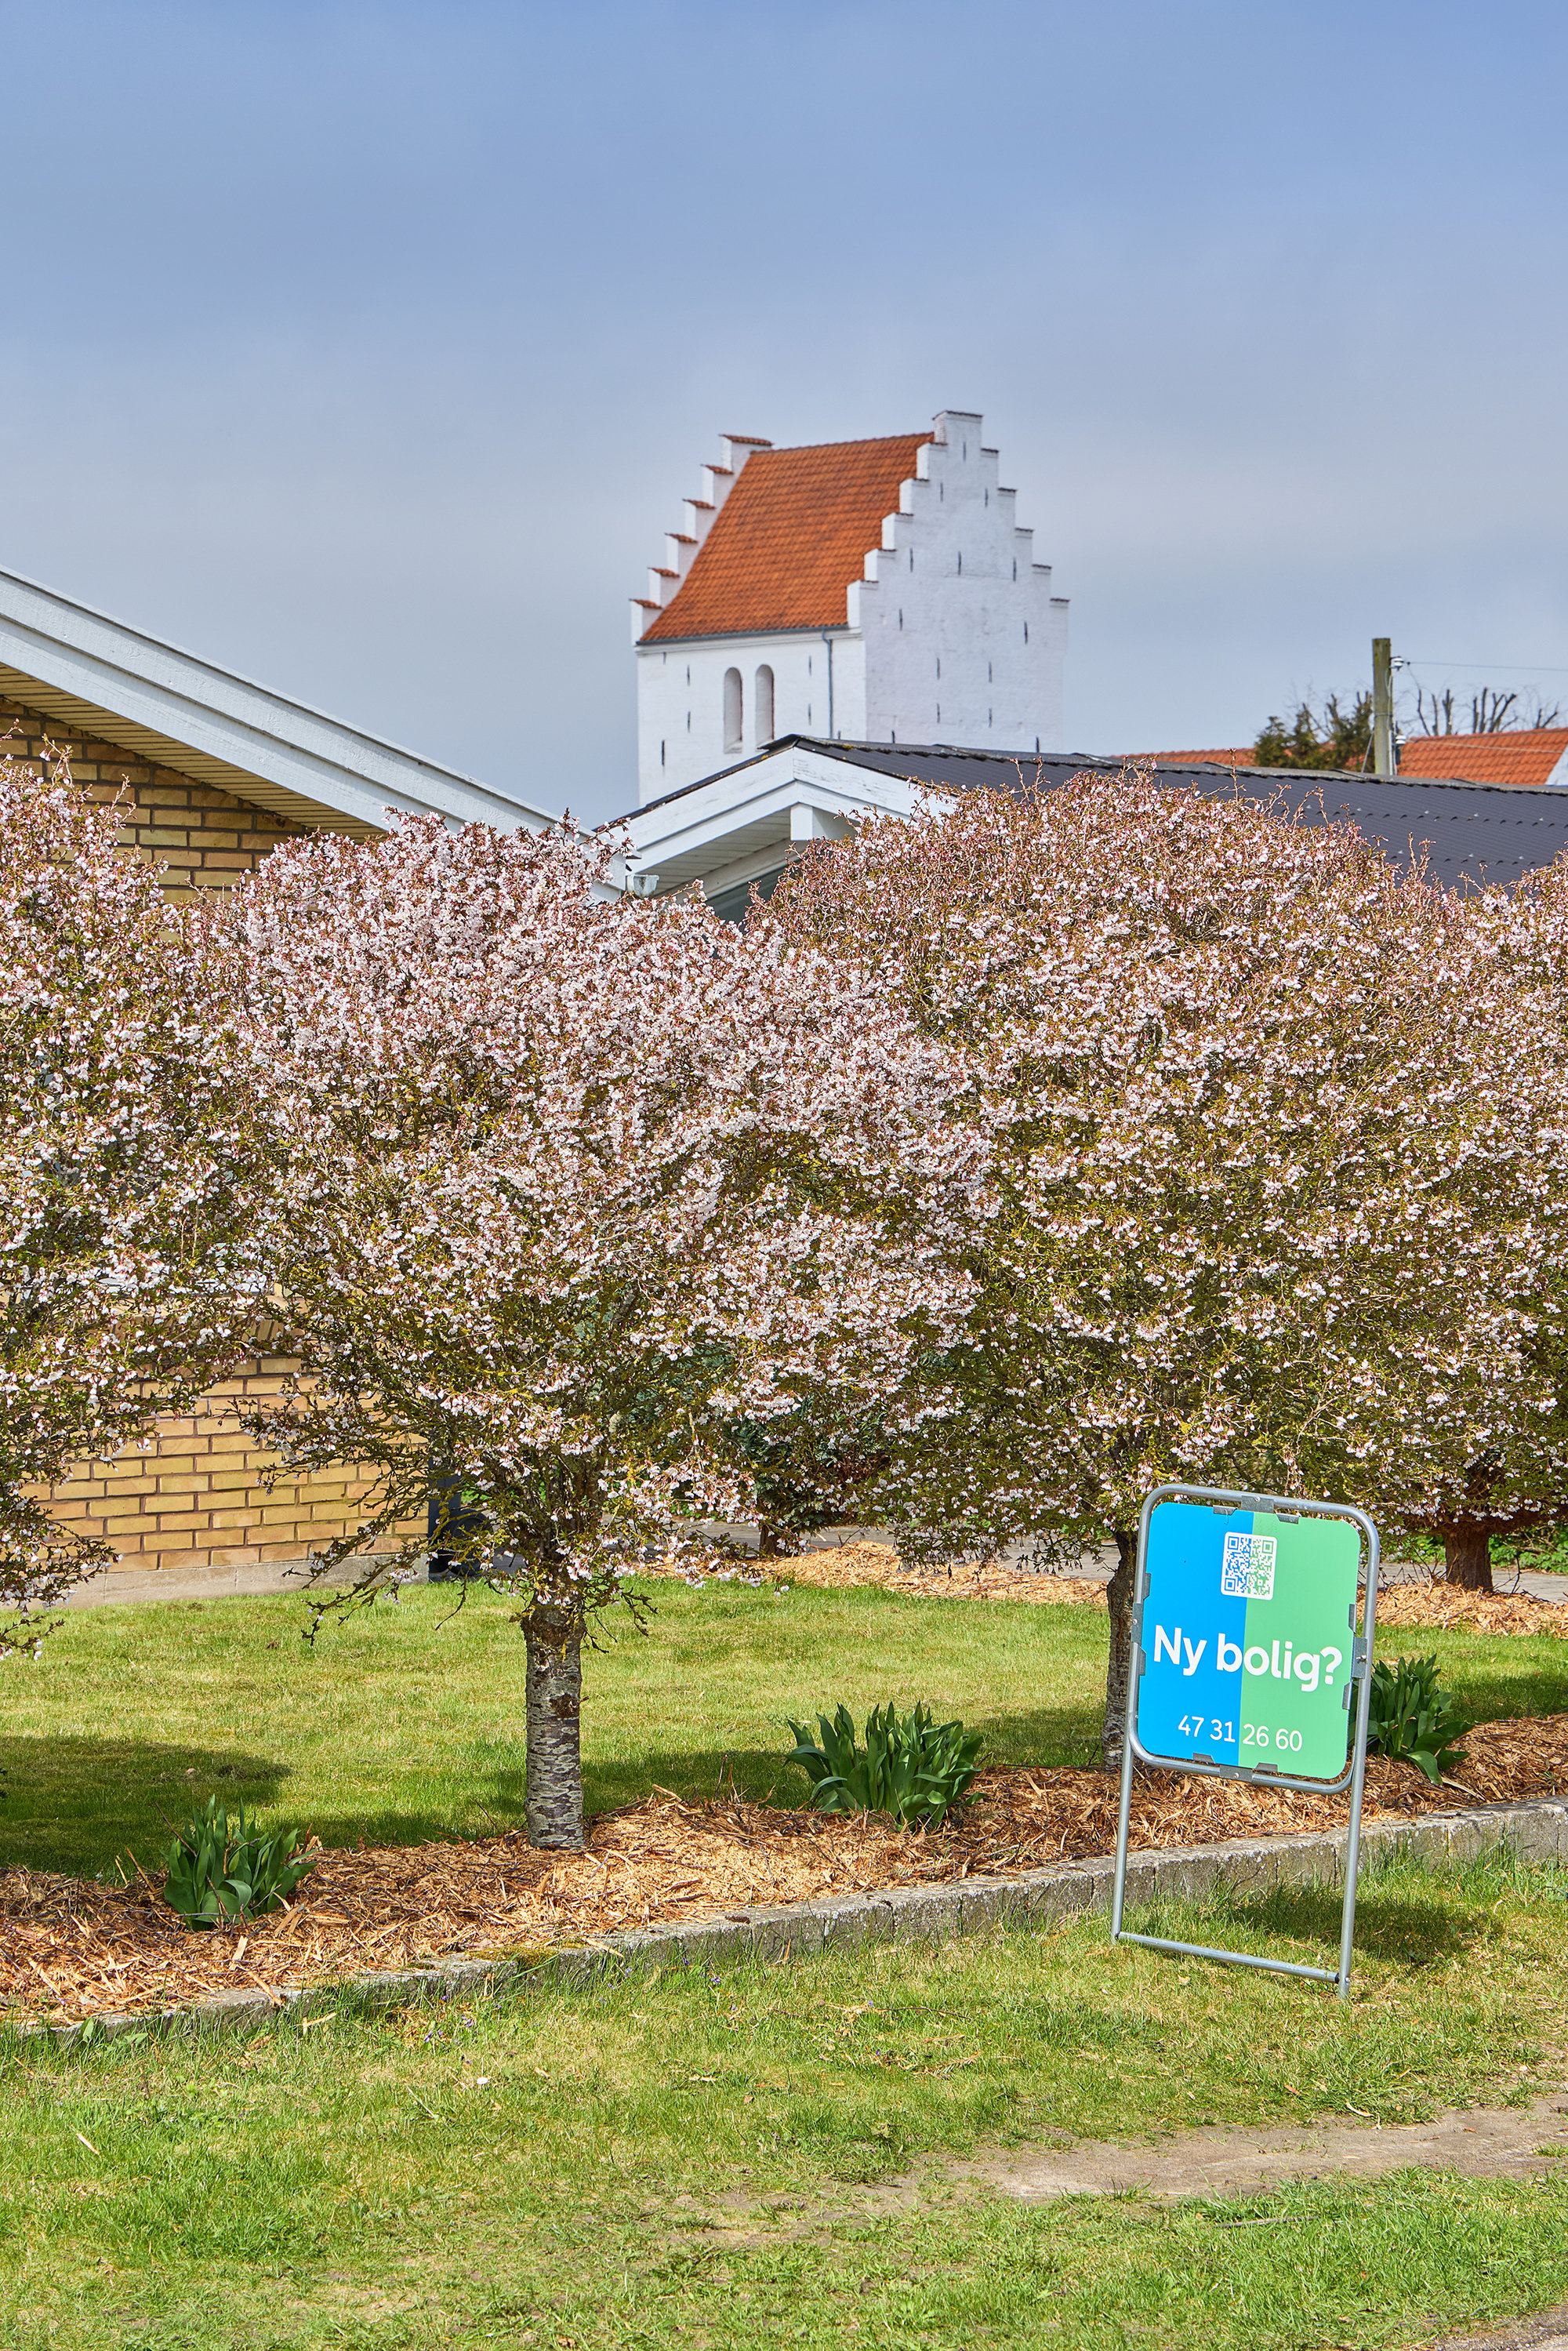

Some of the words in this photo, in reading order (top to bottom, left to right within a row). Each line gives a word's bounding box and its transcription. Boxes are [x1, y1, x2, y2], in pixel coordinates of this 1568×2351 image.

[1154, 1625, 1207, 1676] Ny
[1217, 1633, 1343, 1692] bolig?
[1178, 1715, 1204, 1737] 47
[1210, 1719, 1236, 1742] 31
[1242, 1723, 1269, 1747] 26
[1275, 1728, 1303, 1752] 60
